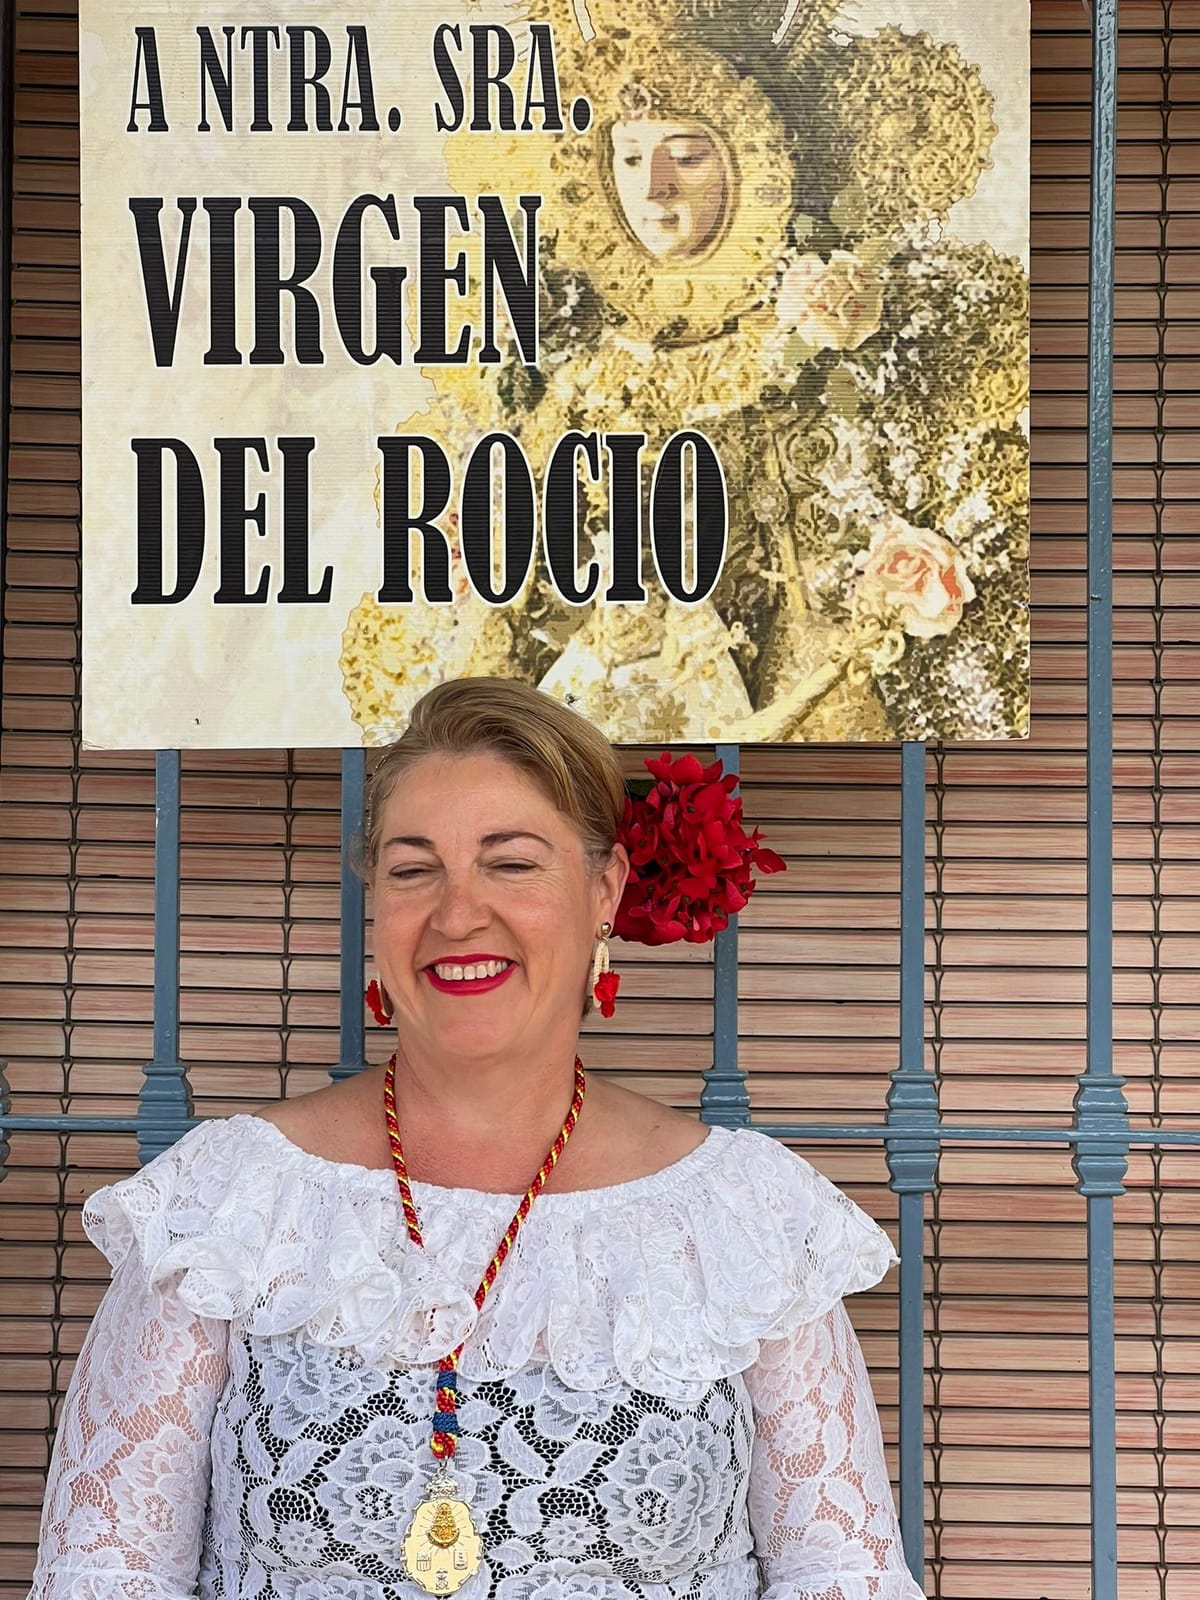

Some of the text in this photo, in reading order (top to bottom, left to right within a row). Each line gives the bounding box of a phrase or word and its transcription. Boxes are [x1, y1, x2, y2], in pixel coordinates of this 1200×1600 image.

[127, 24, 592, 132] A NTRA. SRA.
[128, 195, 542, 367] VIRGEN
[131, 430, 727, 605] DEL ROCIO
